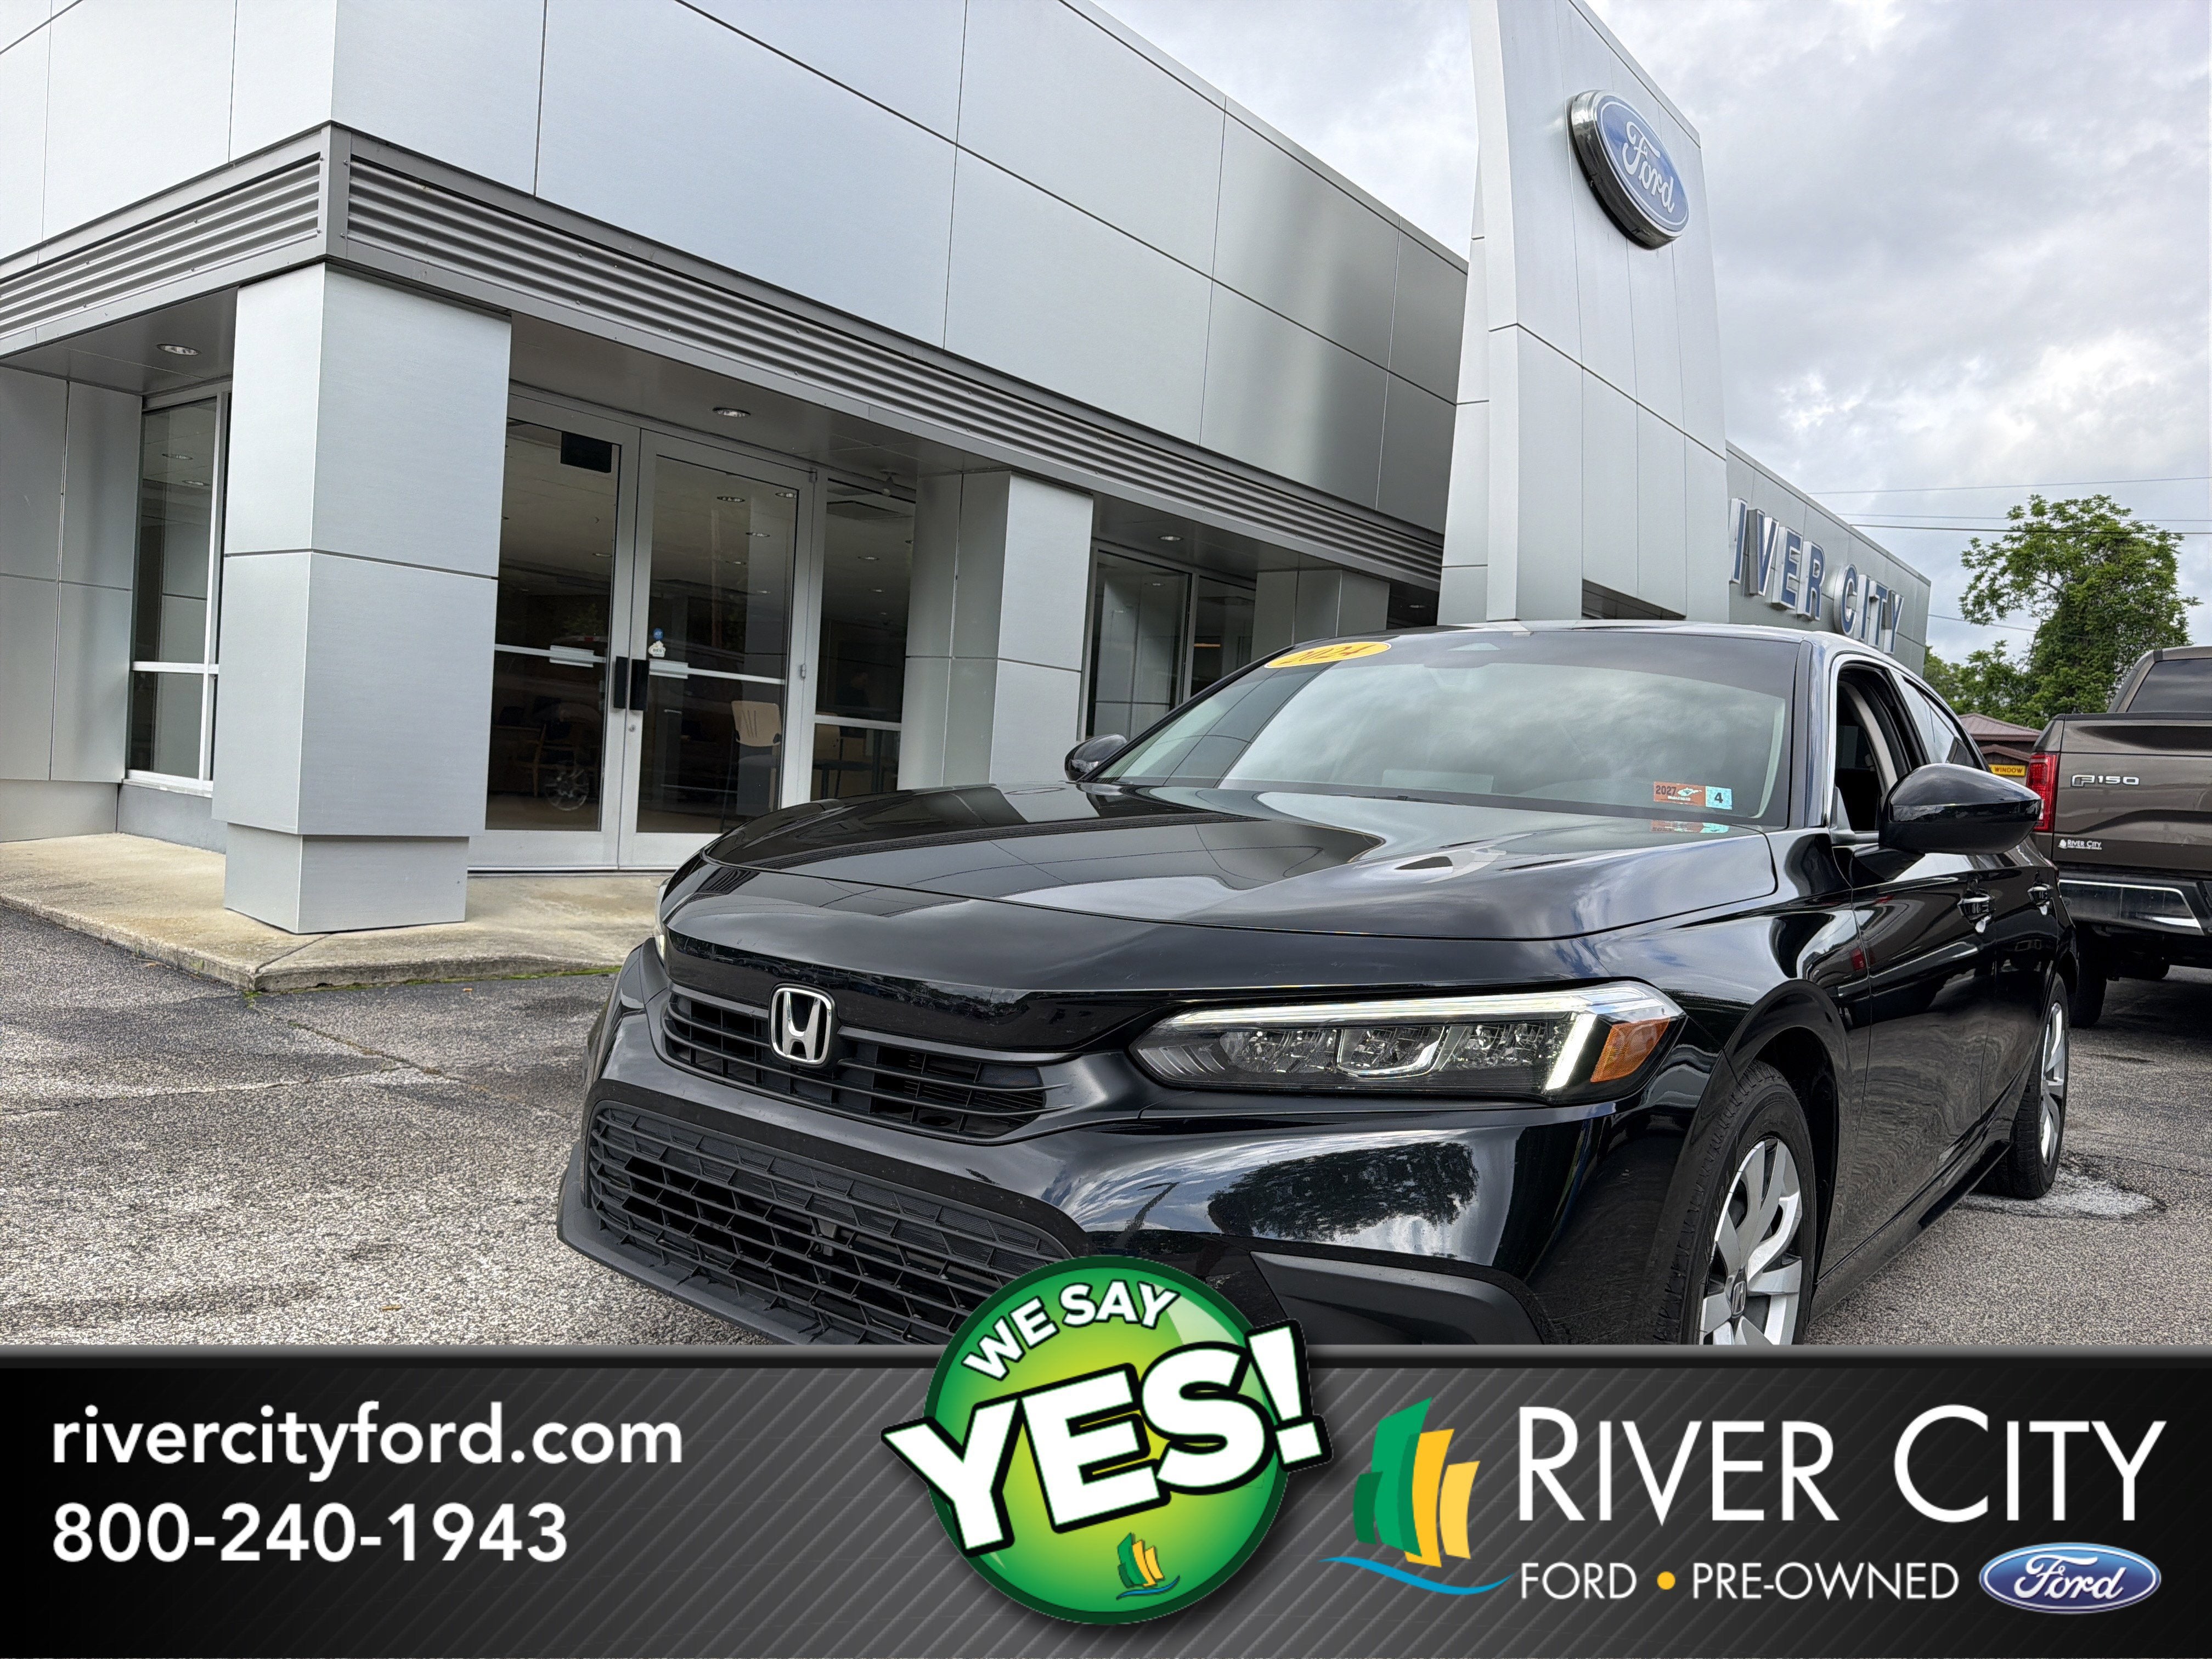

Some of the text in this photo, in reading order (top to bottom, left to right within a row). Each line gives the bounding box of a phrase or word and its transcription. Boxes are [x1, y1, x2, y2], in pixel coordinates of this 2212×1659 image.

[1622, 121, 1674, 213] Ford
[1729, 498, 1905, 654] IVER CITY
[1277, 644, 1378, 665] 2024
[1656, 785, 1677, 795] 2027
[1714, 792, 1723, 803] 4
